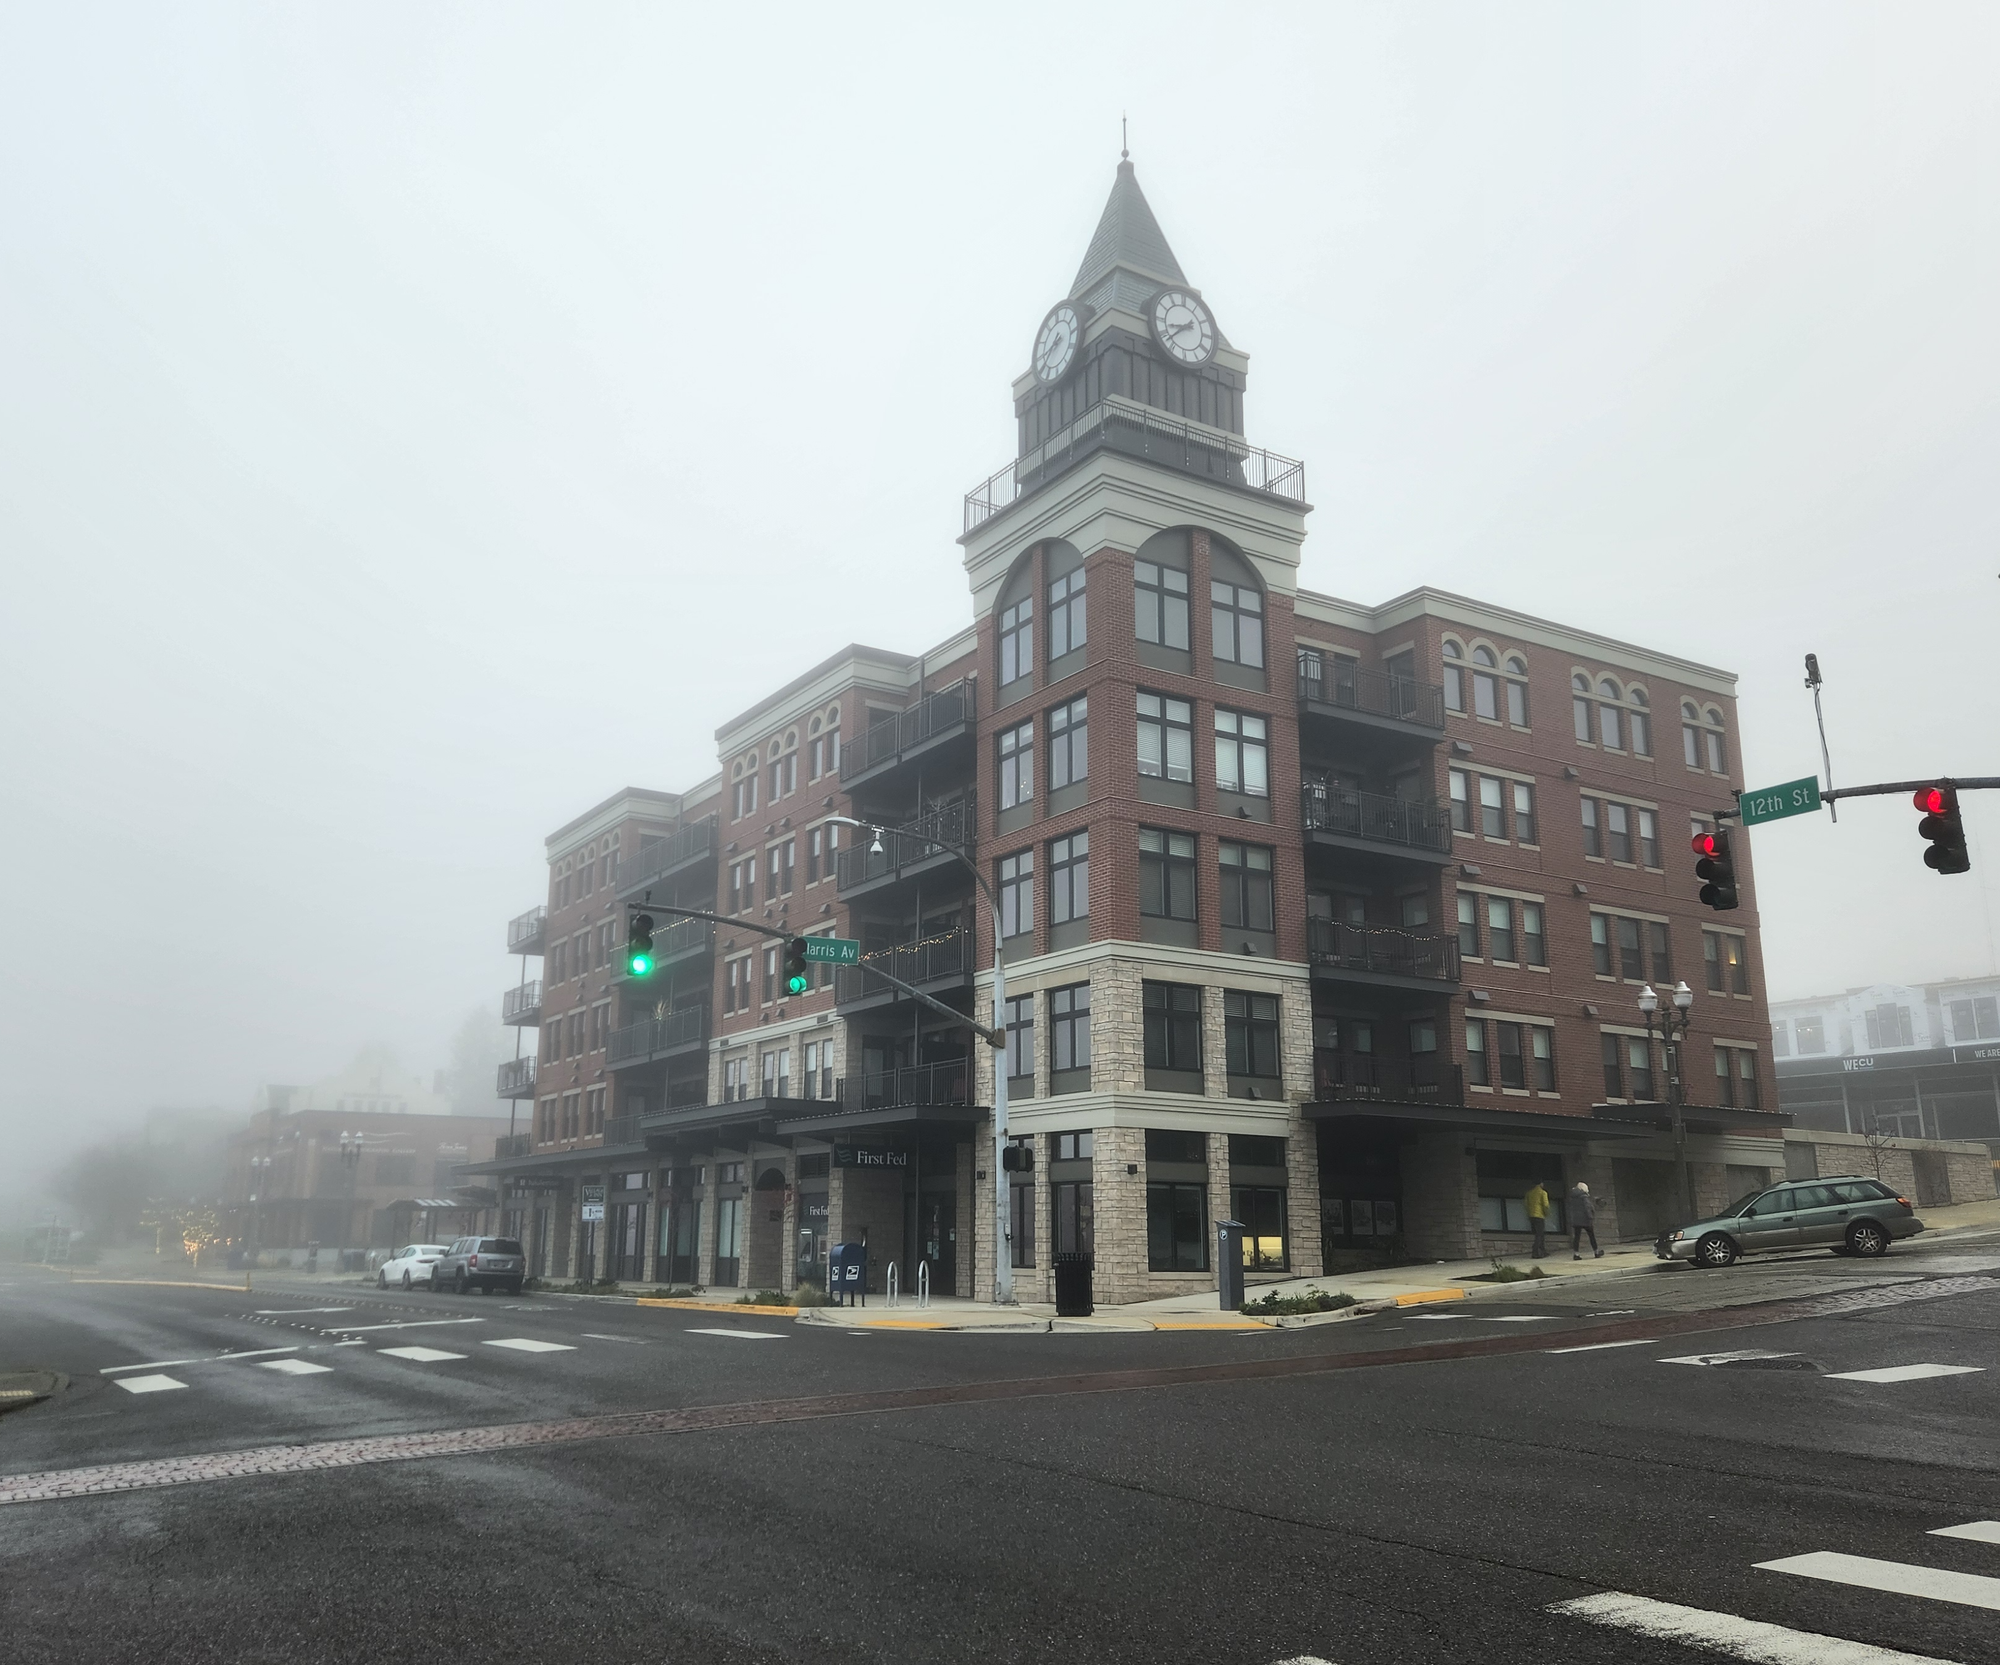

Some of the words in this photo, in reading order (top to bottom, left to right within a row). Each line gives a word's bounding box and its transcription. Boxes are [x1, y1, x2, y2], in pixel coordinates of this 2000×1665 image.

[1750, 795, 1783, 816] 12th
[1793, 788, 1810, 806] St
[841, 945, 854, 958] Av
[1975, 1050, 1986, 1058] WE
[1843, 1058, 1874, 1071] WECU
[857, 1150, 885, 1165] First
[886, 1151, 907, 1166] Fed
